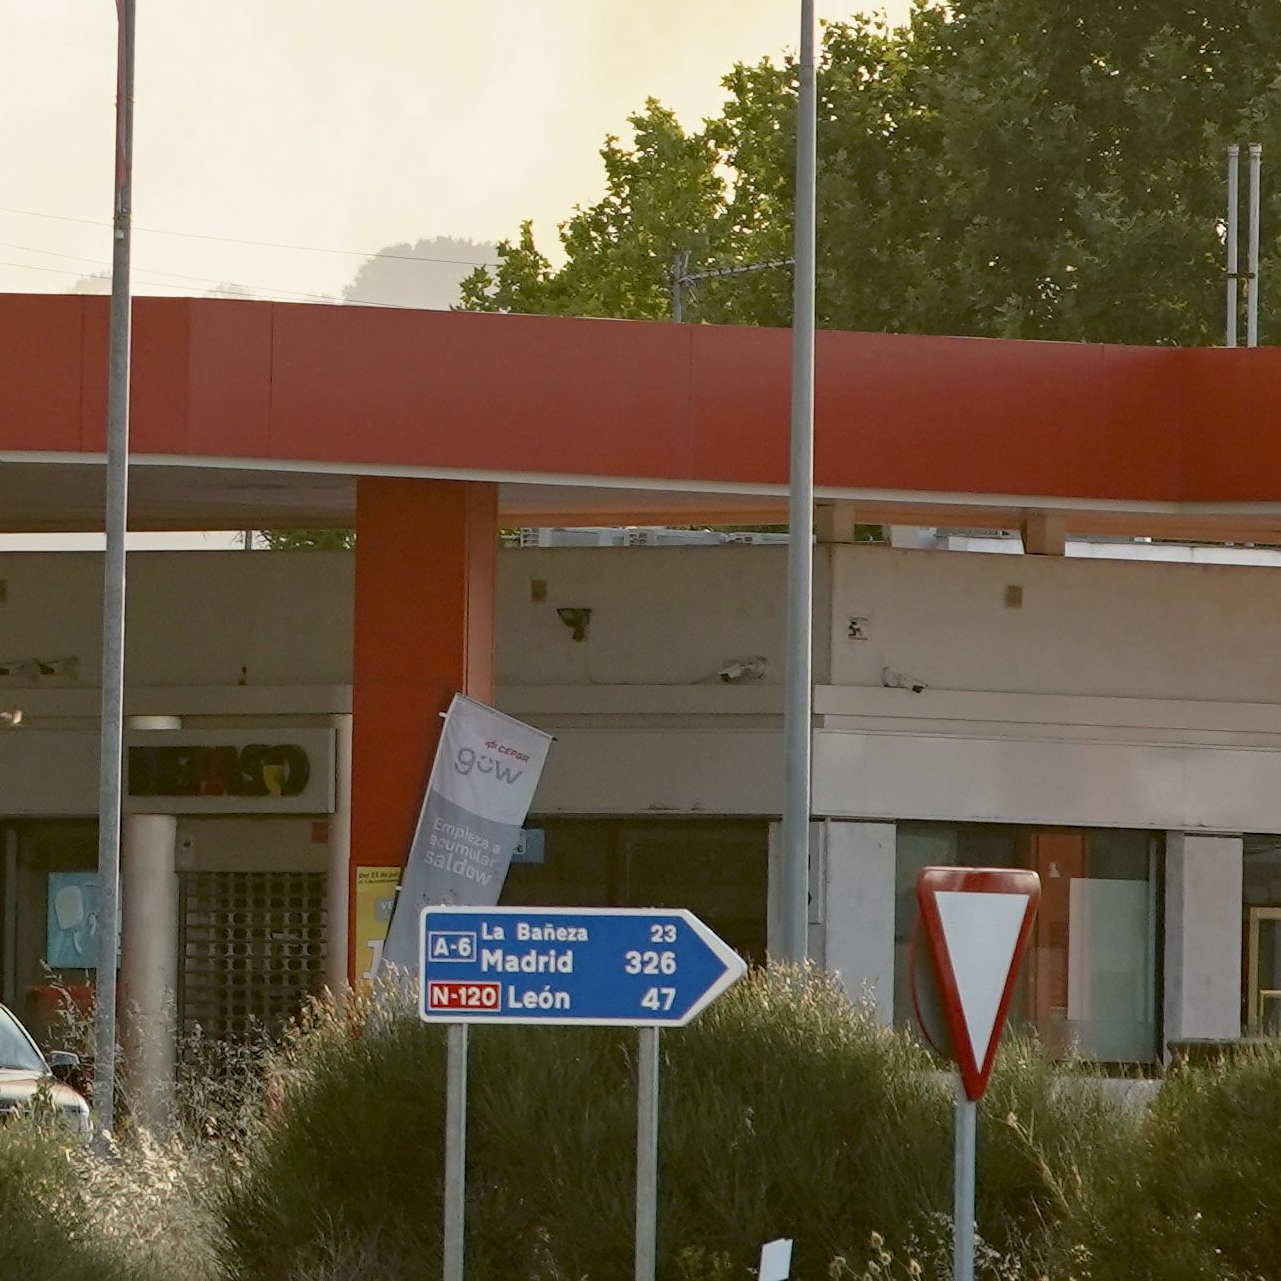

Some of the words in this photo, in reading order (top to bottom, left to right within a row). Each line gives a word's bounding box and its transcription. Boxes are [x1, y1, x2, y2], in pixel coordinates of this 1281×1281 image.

[498, 745, 530, 763] CEPSA
[433, 817, 489, 850] Empieza
[429, 833, 498, 868] acumular
[423, 850, 494, 887] saldow
[481, 922, 505, 941] La
[516, 921, 589, 943] Bañeza
[650, 924, 677, 943] 23
[433, 937, 472, 957] A-6
[481, 949, 573, 974] Madrid
[625, 950, 677, 975] 326
[432, 986, 497, 1007] N-120
[508, 985, 571, 1010] León
[641, 987, 676, 1011] 47
